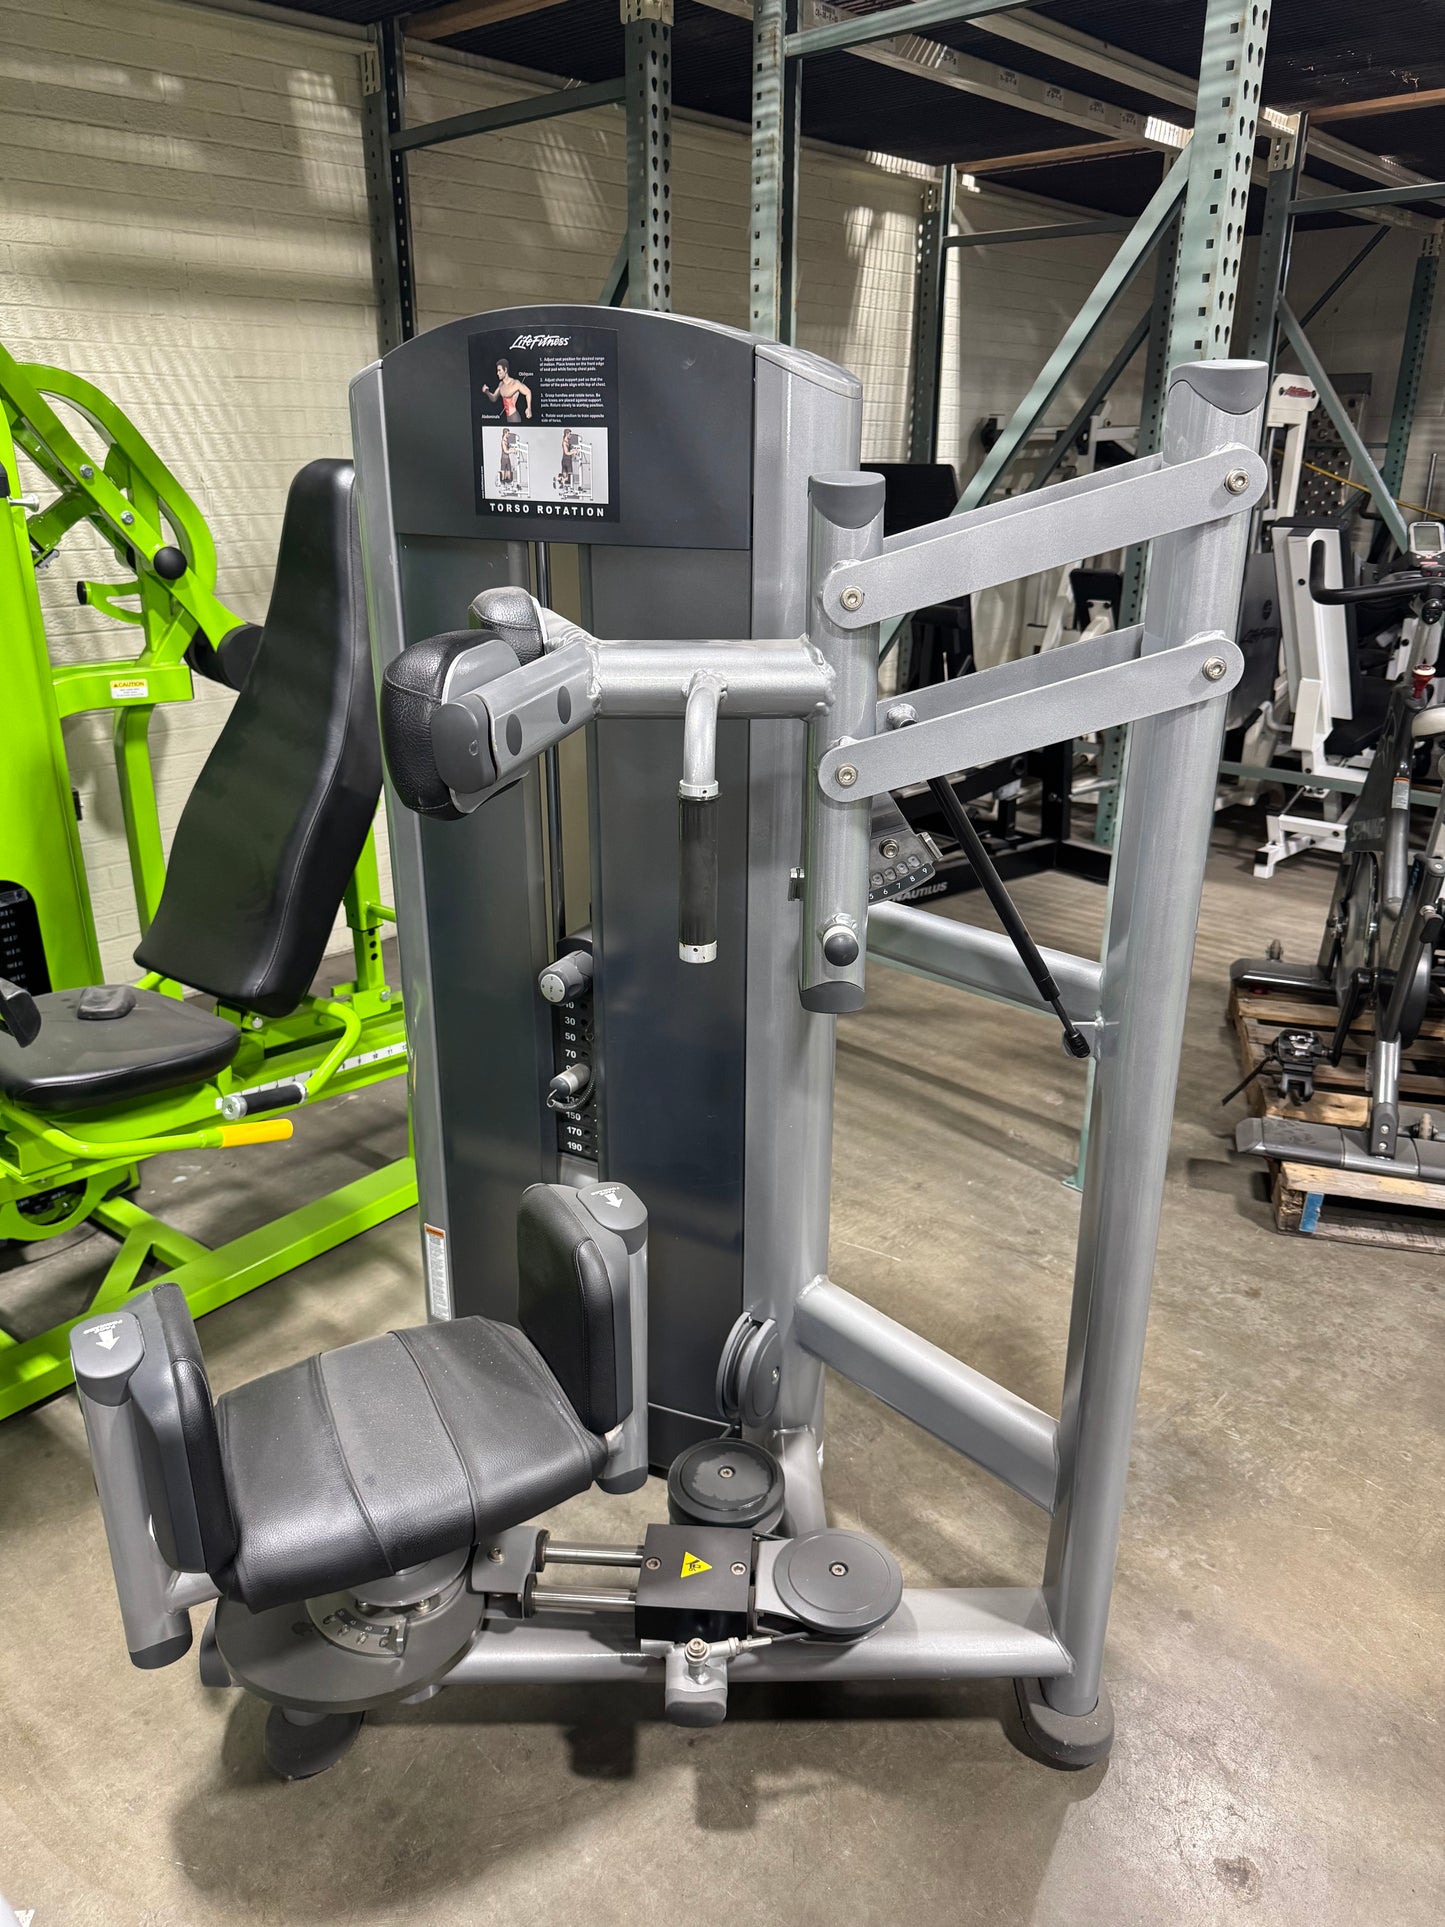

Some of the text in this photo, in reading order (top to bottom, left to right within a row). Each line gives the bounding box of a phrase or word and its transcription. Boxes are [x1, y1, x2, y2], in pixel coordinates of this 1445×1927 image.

[490, 503, 604, 517] TORSO ROTATION
[564, 1016, 576, 1026] 30
[565, 1032, 576, 1042] 50
[565, 1048, 576, 1058] 70
[566, 1111, 580, 1120] 150
[566, 1126, 582, 1136] 170
[567, 1141, 582, 1151] 190
